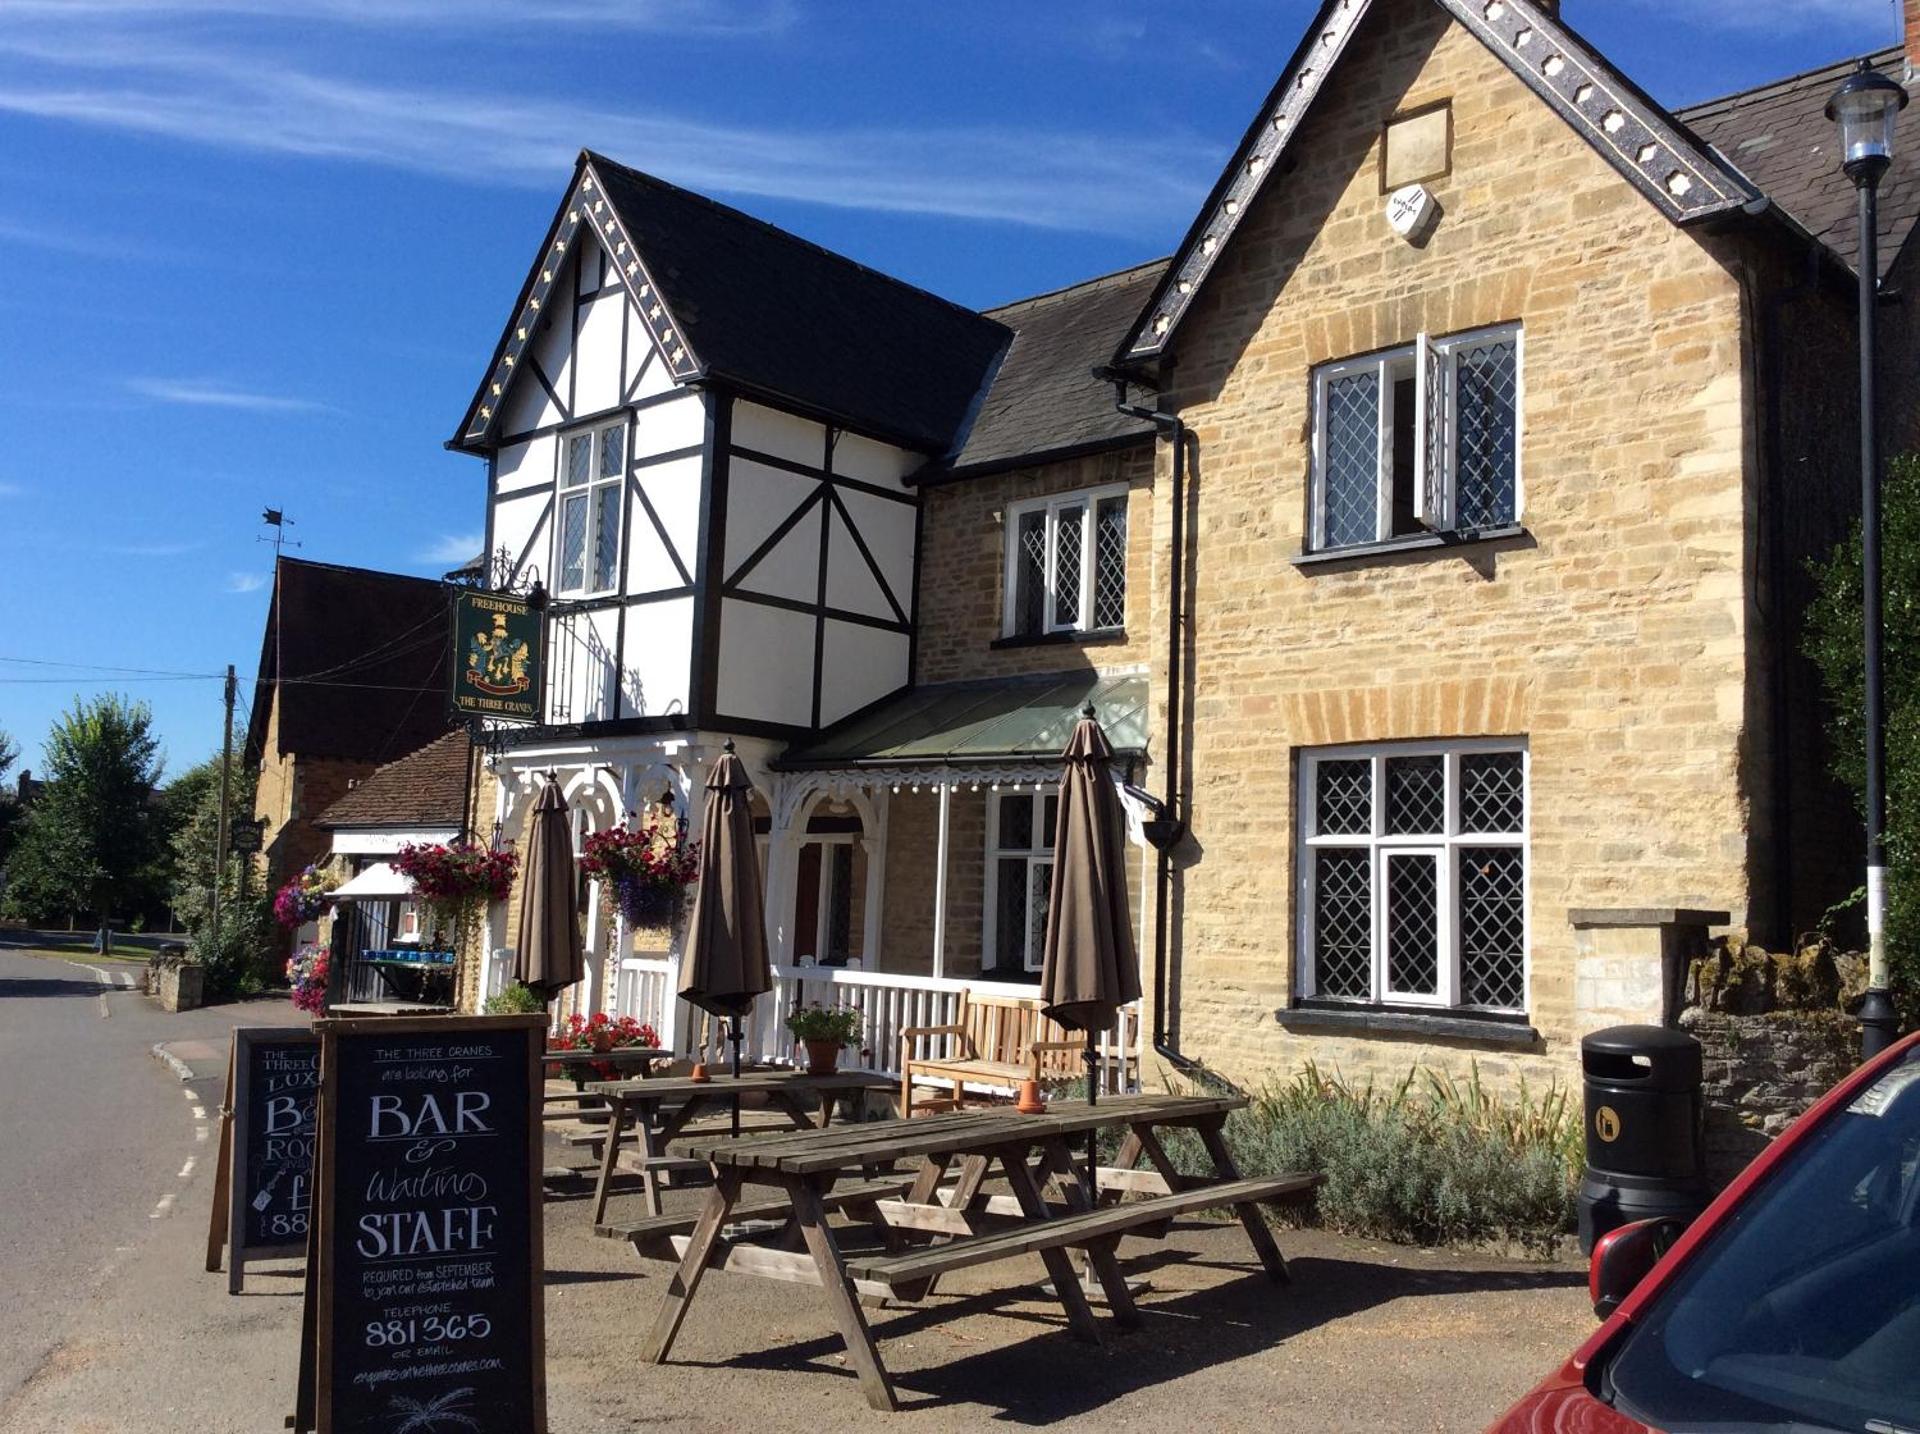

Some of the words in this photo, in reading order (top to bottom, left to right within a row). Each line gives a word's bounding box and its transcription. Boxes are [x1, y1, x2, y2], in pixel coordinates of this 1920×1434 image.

[471, 597, 529, 616] FREEHOUSE
[459, 696, 477, 708] THE
[477, 697, 504, 710] THREE
[504, 701, 533, 713] CRANES
[264, 1050, 289, 1060] THE
[376, 1048, 401, 1060] THE
[407, 1047, 444, 1059] THREE
[448, 1045, 493, 1057] CRANES
[264, 1059, 310, 1070] THREE
[382, 1069, 402, 1081] are
[405, 1065, 449, 1083] looking
[451, 1064, 474, 1083] for
[268, 1072, 317, 1092] LUX
[369, 1091, 495, 1138] BAR
[405, 1139, 457, 1163] &
[366, 1166, 488, 1202] Waiting
[271, 1213, 310, 1235] 88
[356, 1206, 498, 1258] STAFF
[362, 1269, 414, 1284] REQUIRED
[415, 1269, 434, 1280] from
[435, 1261, 494, 1279] SEPTEMBER
[363, 1286, 375, 1298] to
[372, 1285, 397, 1301] join
[397, 1283, 417, 1295] our
[470, 1276, 495, 1289] team
[383, 1302, 453, 1318] TELEPHONE
[391, 1350, 413, 1359] OR
[416, 1345, 454, 1357] EMAIL
